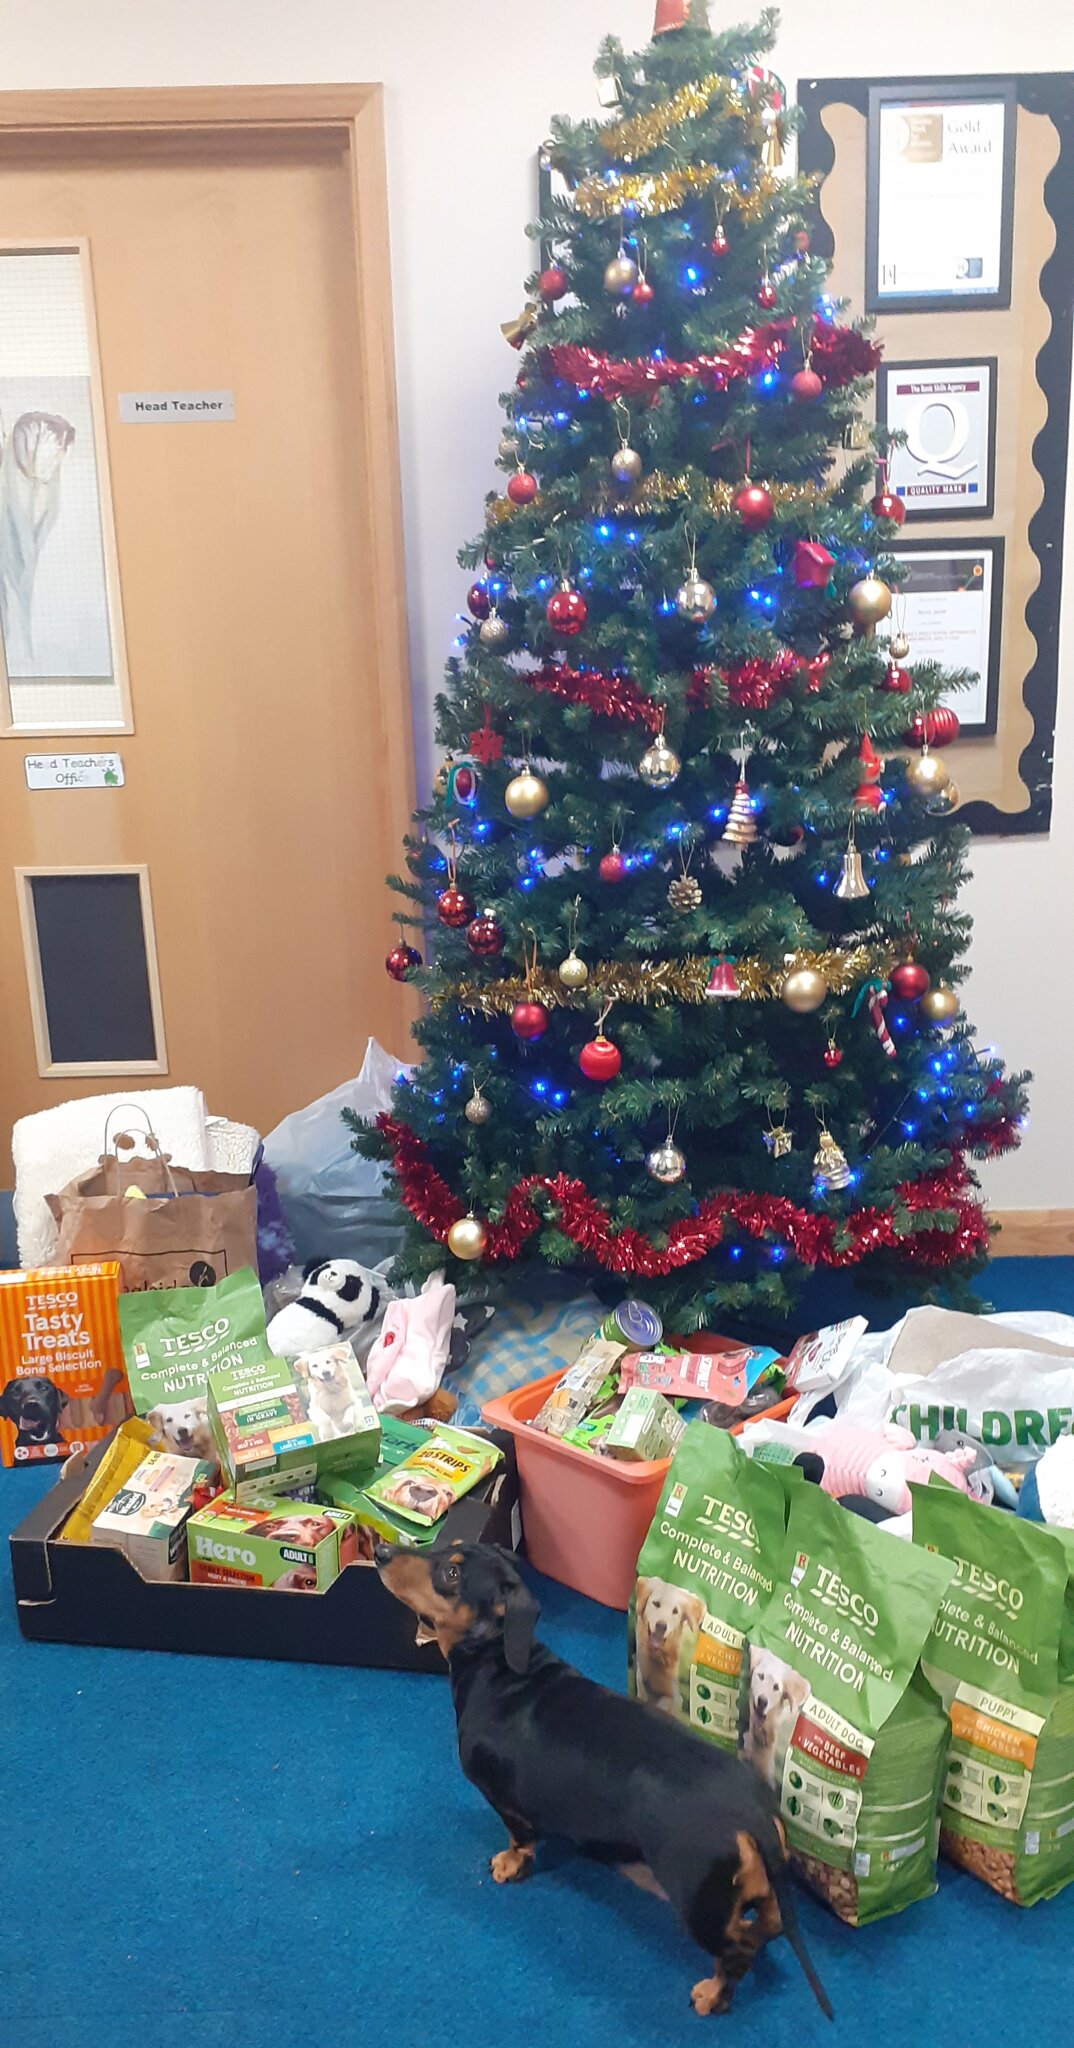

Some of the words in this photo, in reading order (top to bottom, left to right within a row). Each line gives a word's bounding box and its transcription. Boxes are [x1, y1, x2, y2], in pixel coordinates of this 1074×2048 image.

[947, 119, 981, 134] Gold
[947, 140, 993, 155] Award
[135, 401, 168, 411] Head
[171, 400, 223, 411] Teacher
[910, 485, 940, 496] QUALITY
[28, 759, 58, 769] Hed
[55, 772, 85, 785] Offic
[25, 1291, 79, 1307] TESCO
[24, 1312, 84, 1332] Tasty
[21, 1331, 91, 1350] Treats
[160, 1317, 230, 1354] TESCO
[16, 1364, 46, 1376] Bone
[48, 1359, 102, 1373] Selection
[21, 1354, 53, 1367] Large
[55, 1348, 94, 1362] Biscuit
[141, 1362, 199, 1381] Complete
[201, 1357, 209, 1368] &
[211, 1336, 258, 1362] Balanced
[230, 1364, 266, 1378] TESCO
[233, 1380, 274, 1397] NUTRITION
[890, 1403, 1074, 1447] CHILDRE
[417, 1450, 432, 1459] 20
[432, 1451, 471, 1474] STRIPS
[703, 1494, 760, 1543] TESC
[195, 1535, 256, 1567] Hero
[283, 1549, 308, 1563] ADULT
[660, 1521, 721, 1560] Complete
[722, 1551, 731, 1565] &
[732, 1556, 773, 1593] Balanced
[673, 1549, 758, 1606] NUTRITION
[952, 1556, 1024, 1611] TESCO
[817, 1564, 879, 1628] TESCO
[707, 1622, 738, 1645] ADULT
[974, 1615, 985, 1629] &
[784, 1593, 829, 1636] Complete
[830, 1628, 840, 1644] &
[840, 1634, 894, 1682] Balanced
[932, 1618, 1020, 1675] UTRITION
[785, 1622, 867, 1692] NUTRITION
[979, 1696, 1018, 1721] PUPPY
[809, 1704, 841, 1731] ADULT
[841, 1728, 864, 1750] DOG
[976, 1719, 1022, 1746] CHICKEN
[802, 1739, 862, 1776] VEGETABLES
[823, 1740, 846, 1760] BEEF
